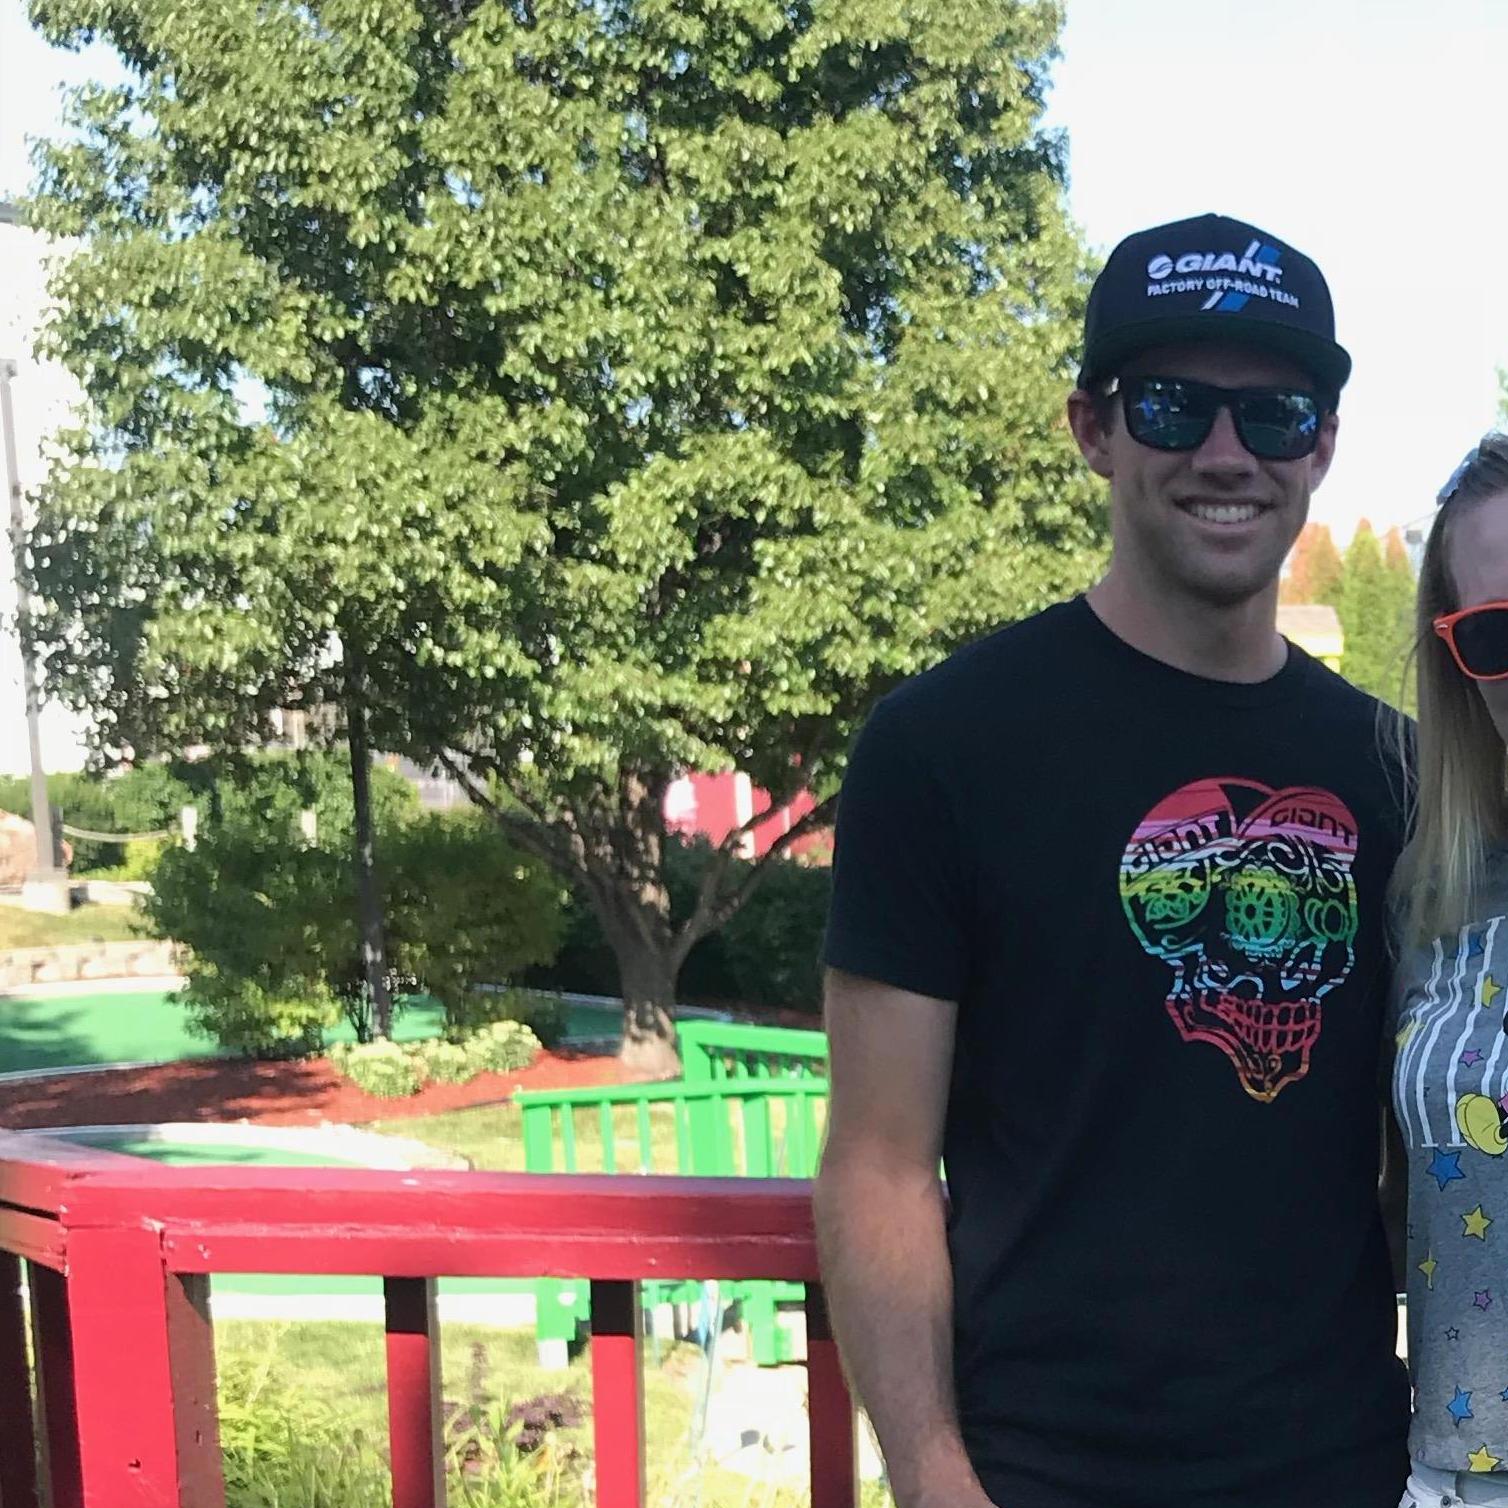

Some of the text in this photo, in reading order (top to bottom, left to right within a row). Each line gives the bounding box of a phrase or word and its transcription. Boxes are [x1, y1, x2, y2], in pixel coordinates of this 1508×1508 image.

[1175, 251, 1283, 282] GIANT
[1147, 278, 1299, 308] FACTORY OFF-ROAD TEAM
